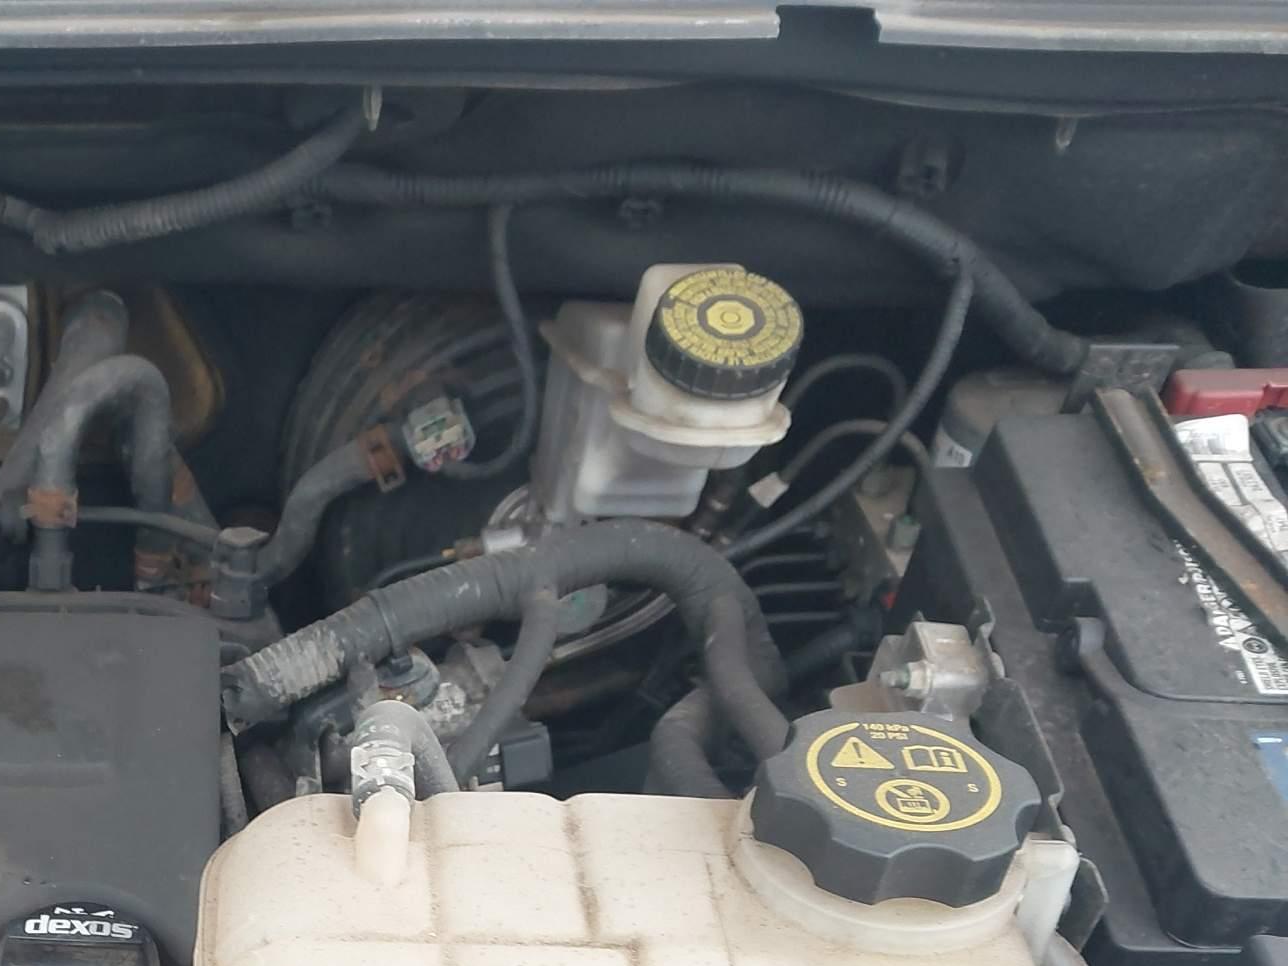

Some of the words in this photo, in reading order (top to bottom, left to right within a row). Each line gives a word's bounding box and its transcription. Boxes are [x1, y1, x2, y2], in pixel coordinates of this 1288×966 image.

[862, 723, 885, 731] 140
[885, 723, 910, 732] kPa
[887, 732, 909, 740] PSI
[24, 915, 134, 939] dexos
